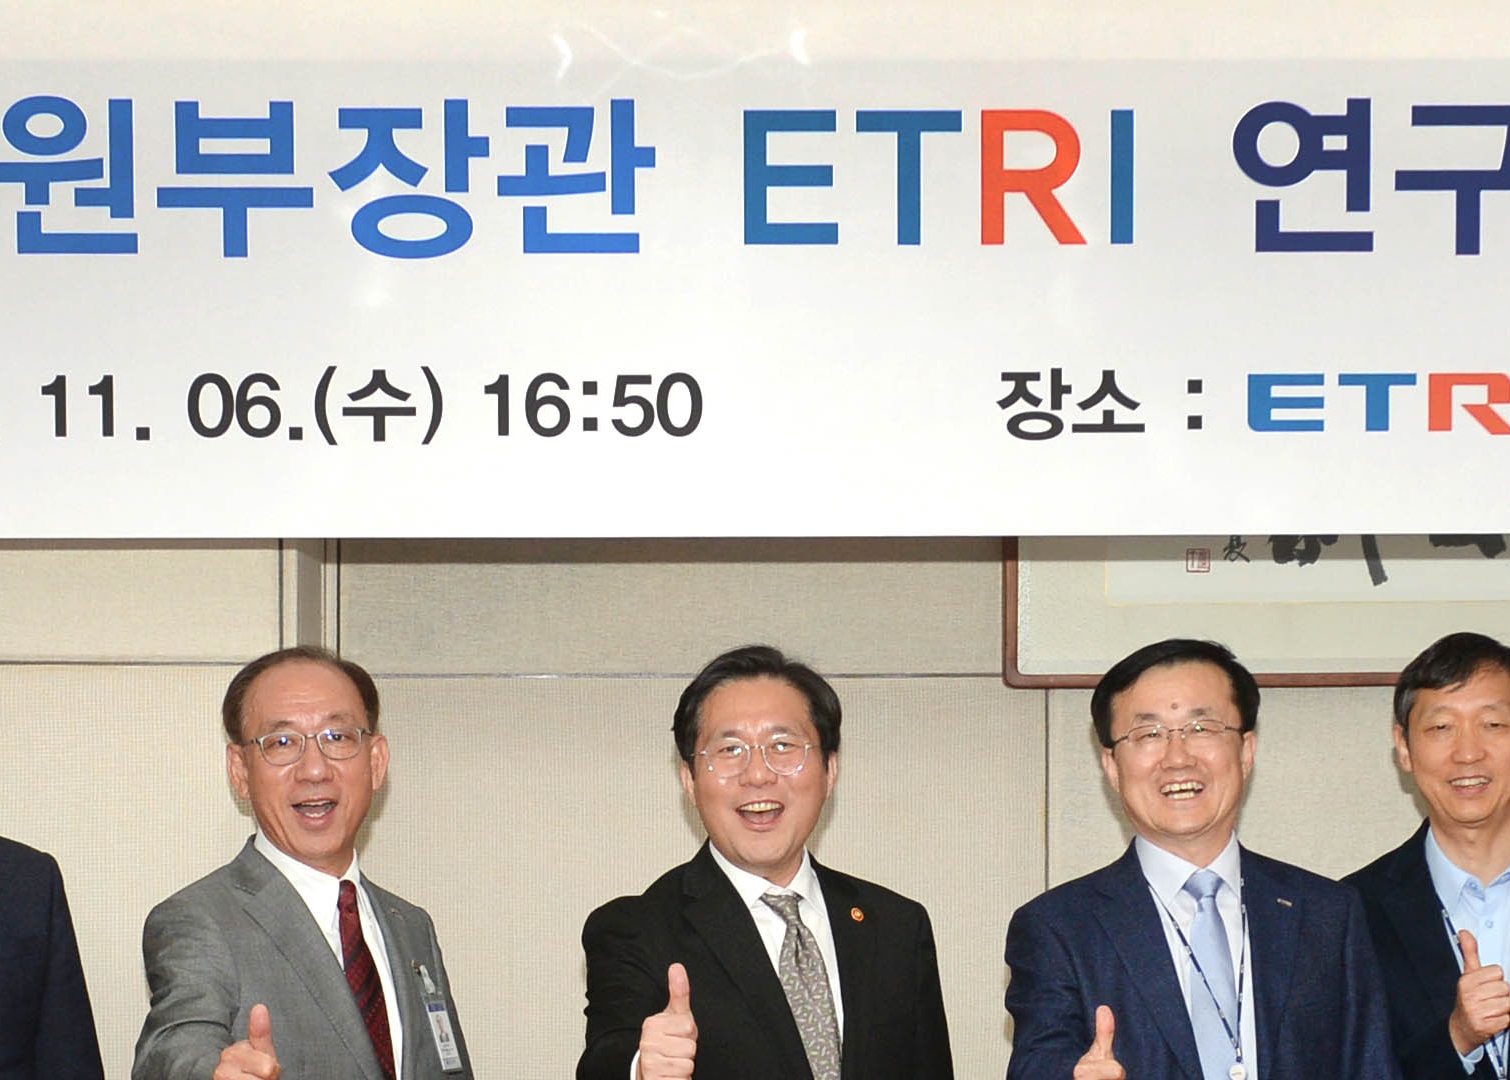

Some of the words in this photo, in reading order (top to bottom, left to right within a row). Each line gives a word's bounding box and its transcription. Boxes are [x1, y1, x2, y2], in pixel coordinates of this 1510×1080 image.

[742, 108, 1136, 247] ETRI
[40, 373, 152, 442] 11.
[186, 364, 444, 447] 06.(수)
[483, 371, 704, 439] 16:50
[995, 366, 1147, 442] 장소
